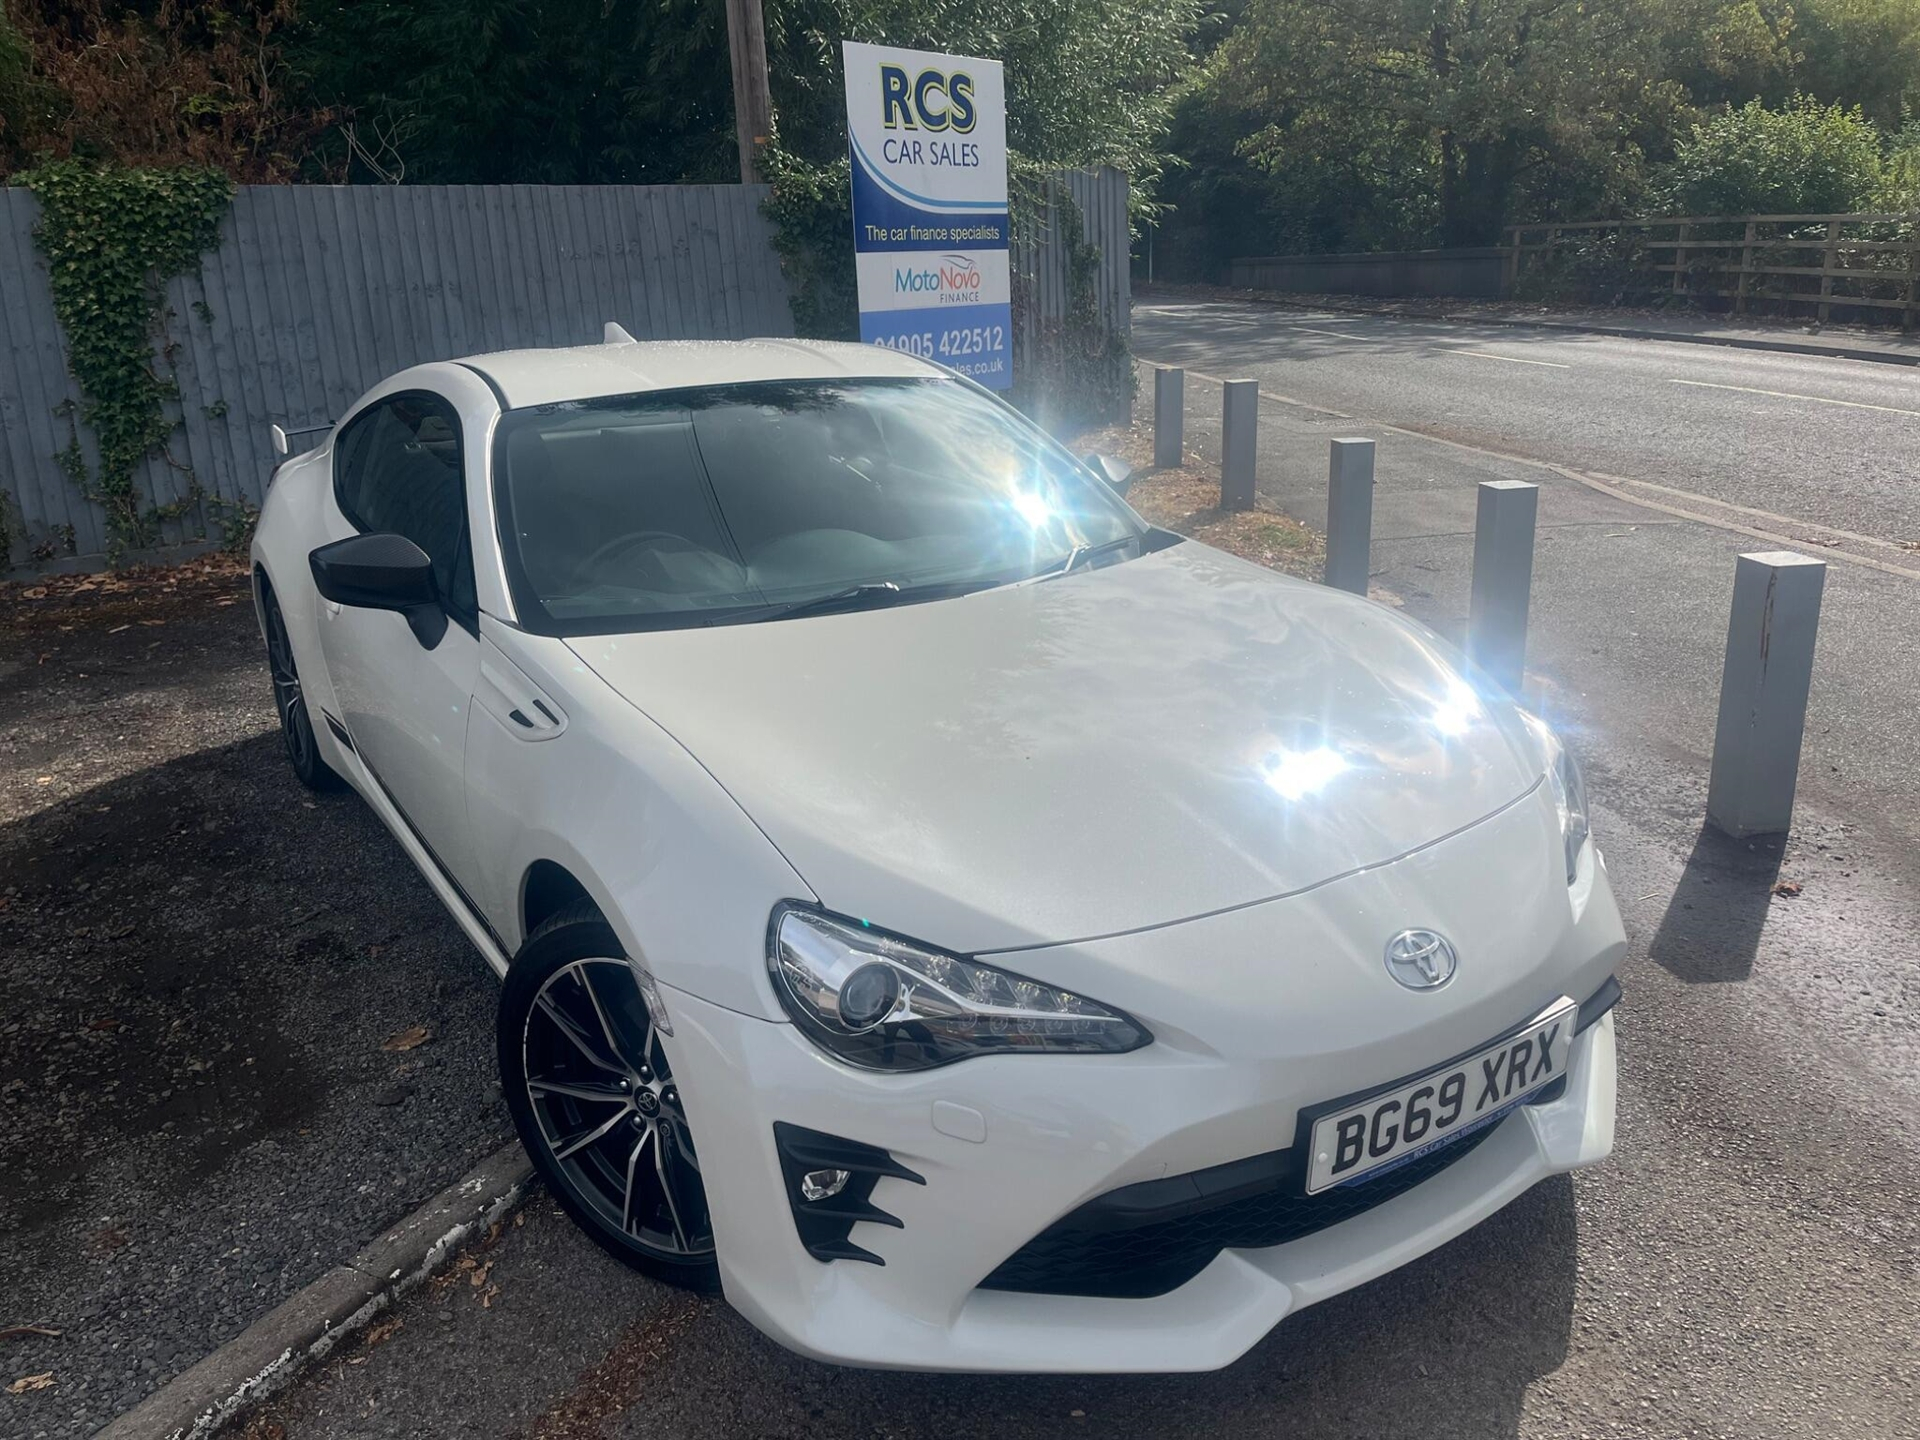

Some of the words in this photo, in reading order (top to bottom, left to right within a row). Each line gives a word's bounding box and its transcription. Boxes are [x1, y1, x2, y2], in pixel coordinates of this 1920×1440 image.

[879, 62, 977, 134] RCS
[883, 139, 924, 165] CAR
[930, 141, 979, 167] SALES
[865, 225, 888, 241] The
[890, 229, 907, 241] car
[910, 225, 947, 241] finance
[950, 225, 1000, 243] specialists
[895, 265, 981, 293] MotoNovo
[940, 292, 980, 303] FINANCE
[939, 326, 1004, 356] 422512
[1331, 1072, 1466, 1175] BG69
[1475, 1022, 1560, 1112] XRX
